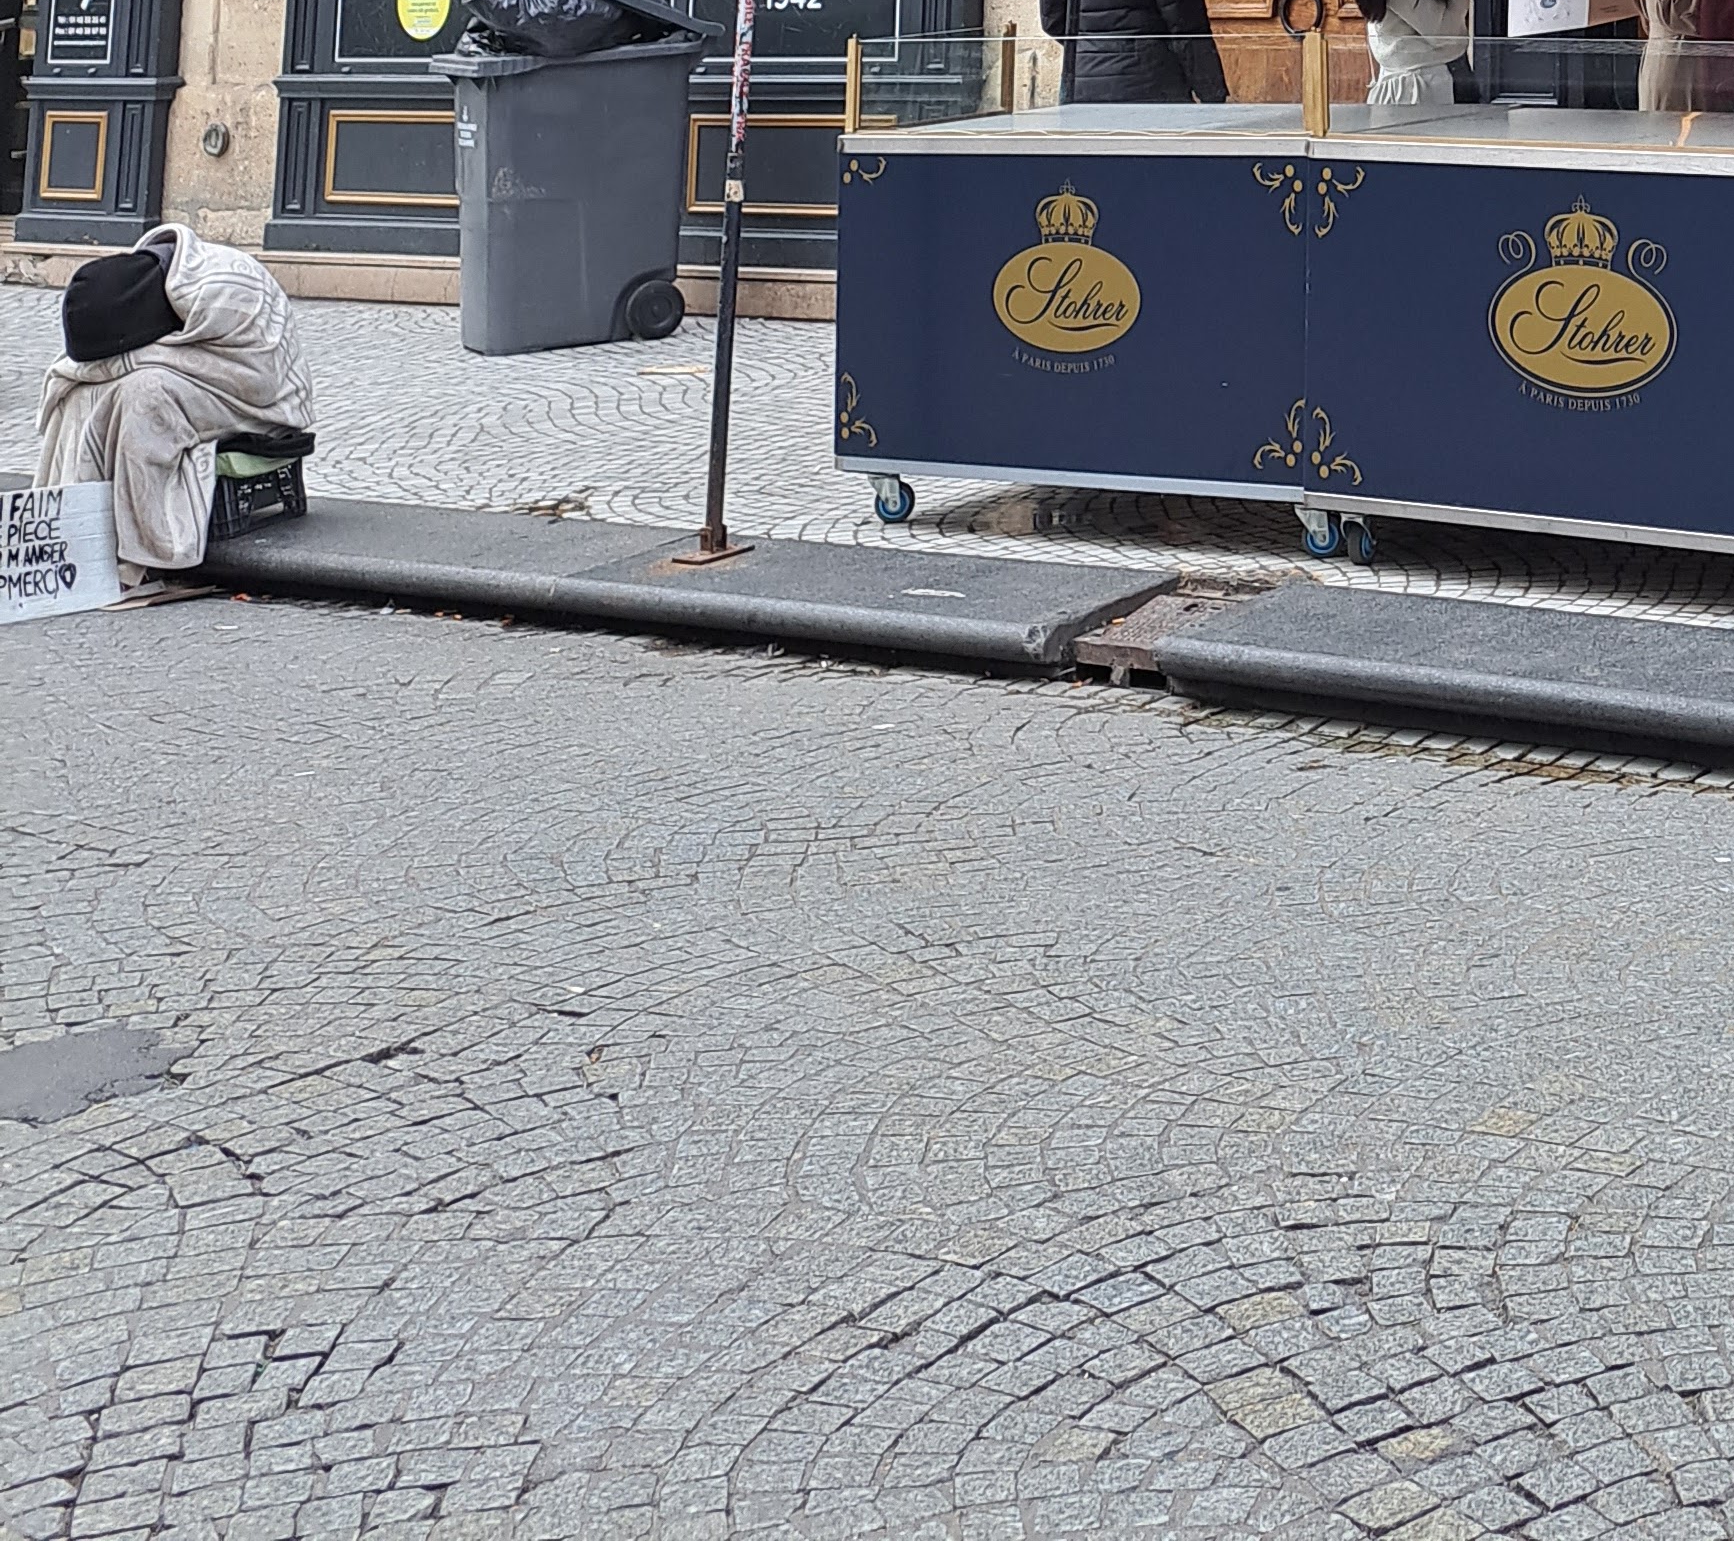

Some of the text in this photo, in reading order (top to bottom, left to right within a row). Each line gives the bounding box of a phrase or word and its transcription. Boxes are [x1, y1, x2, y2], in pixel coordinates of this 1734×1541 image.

[1005, 256, 1129, 327] Stohrer
[1509, 280, 1656, 360] Stohrer
[1022, 354, 1051, 372] PARIS
[1054, 361, 1090, 374] DEPUIS
[1093, 354, 1116, 371] 1730
[1529, 388, 1565, 409] PARIS
[1568, 397, 1611, 412] DEPUIS
[1615, 393, 1641, 410] 1730
[10, 489, 63, 521] FAIM
[8, 517, 61, 546] PIECE
[7, 541, 68, 568] MANGER
